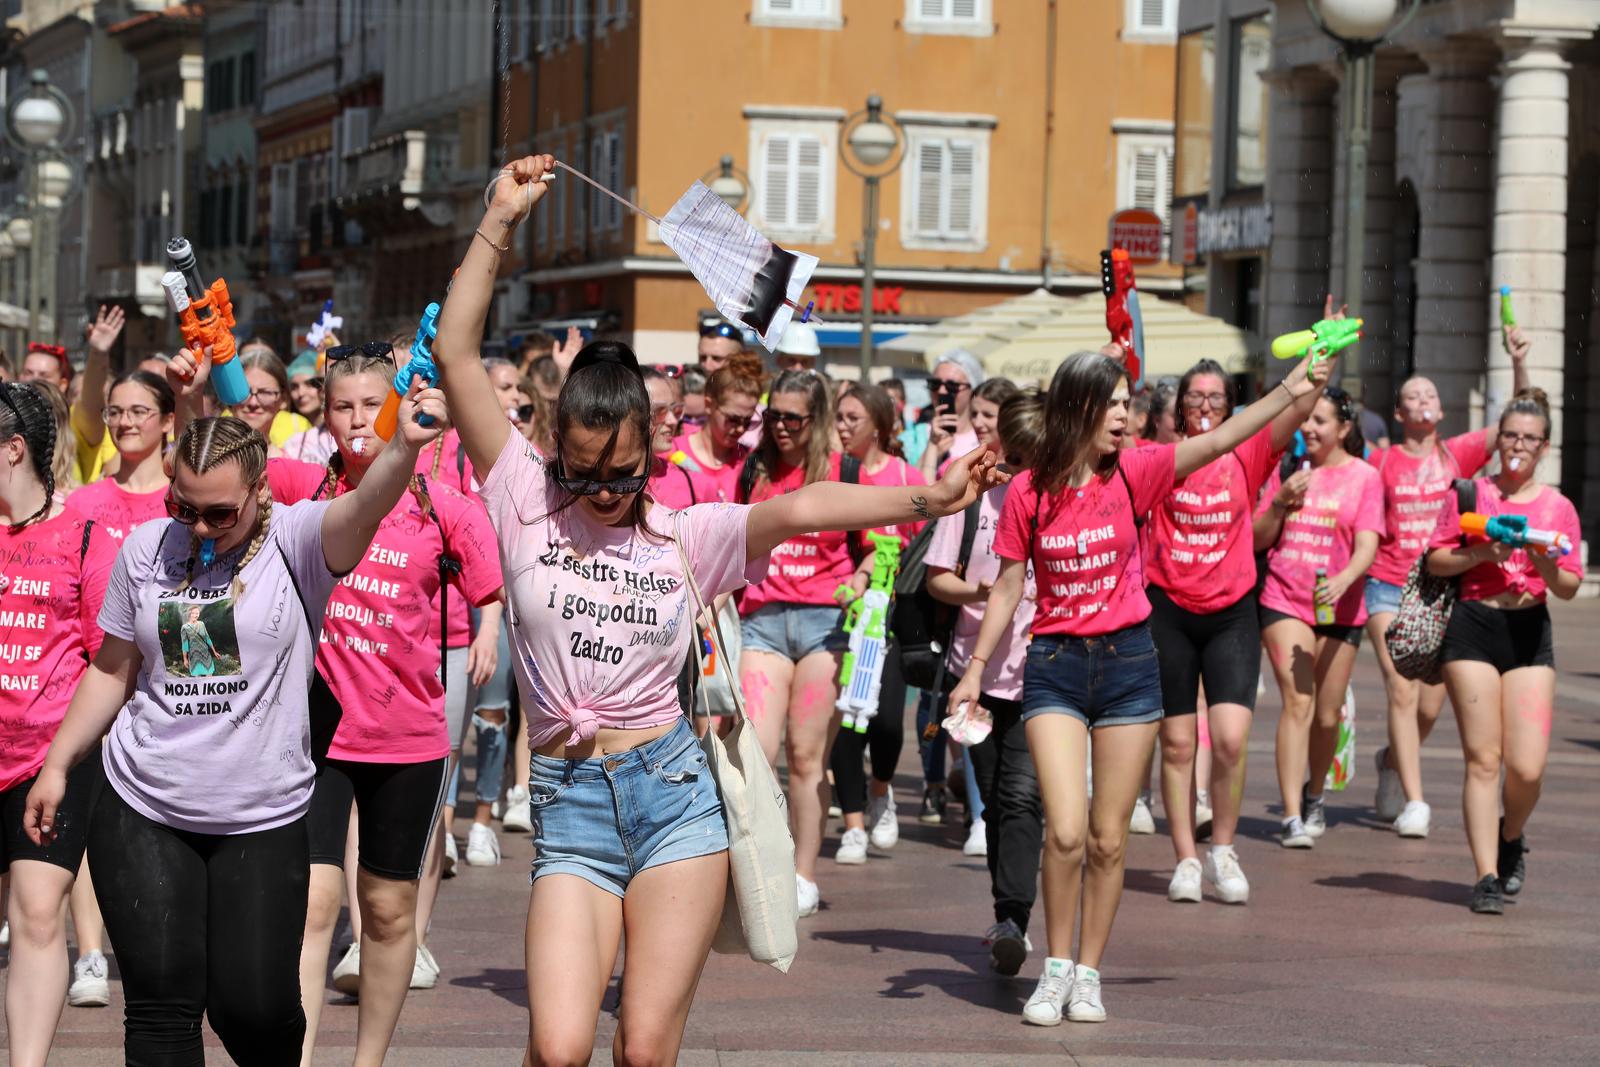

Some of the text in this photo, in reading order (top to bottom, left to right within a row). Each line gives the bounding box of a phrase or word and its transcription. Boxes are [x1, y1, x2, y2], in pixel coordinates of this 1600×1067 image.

[1041, 534, 1077, 549] KADA
[368, 543, 409, 569] ŽENE
[1045, 551, 1117, 573] TULUMARE
[337, 572, 401, 599] UMARE
[562, 555, 620, 582] sestre
[624, 570, 678, 596] Helge
[1103, 576, 1117, 590] SE
[12, 576, 51, 597] ŽENE
[547, 584, 557, 608] i
[562, 592, 658, 628] gospodin
[376, 612, 394, 628] SE
[24, 646, 42, 661] SE
[345, 635, 389, 657] PRAVE
[570, 631, 624, 665] Zadro
[164, 679, 249, 697] MOJA IKONO
[174, 700, 232, 716] SA ZIDA
